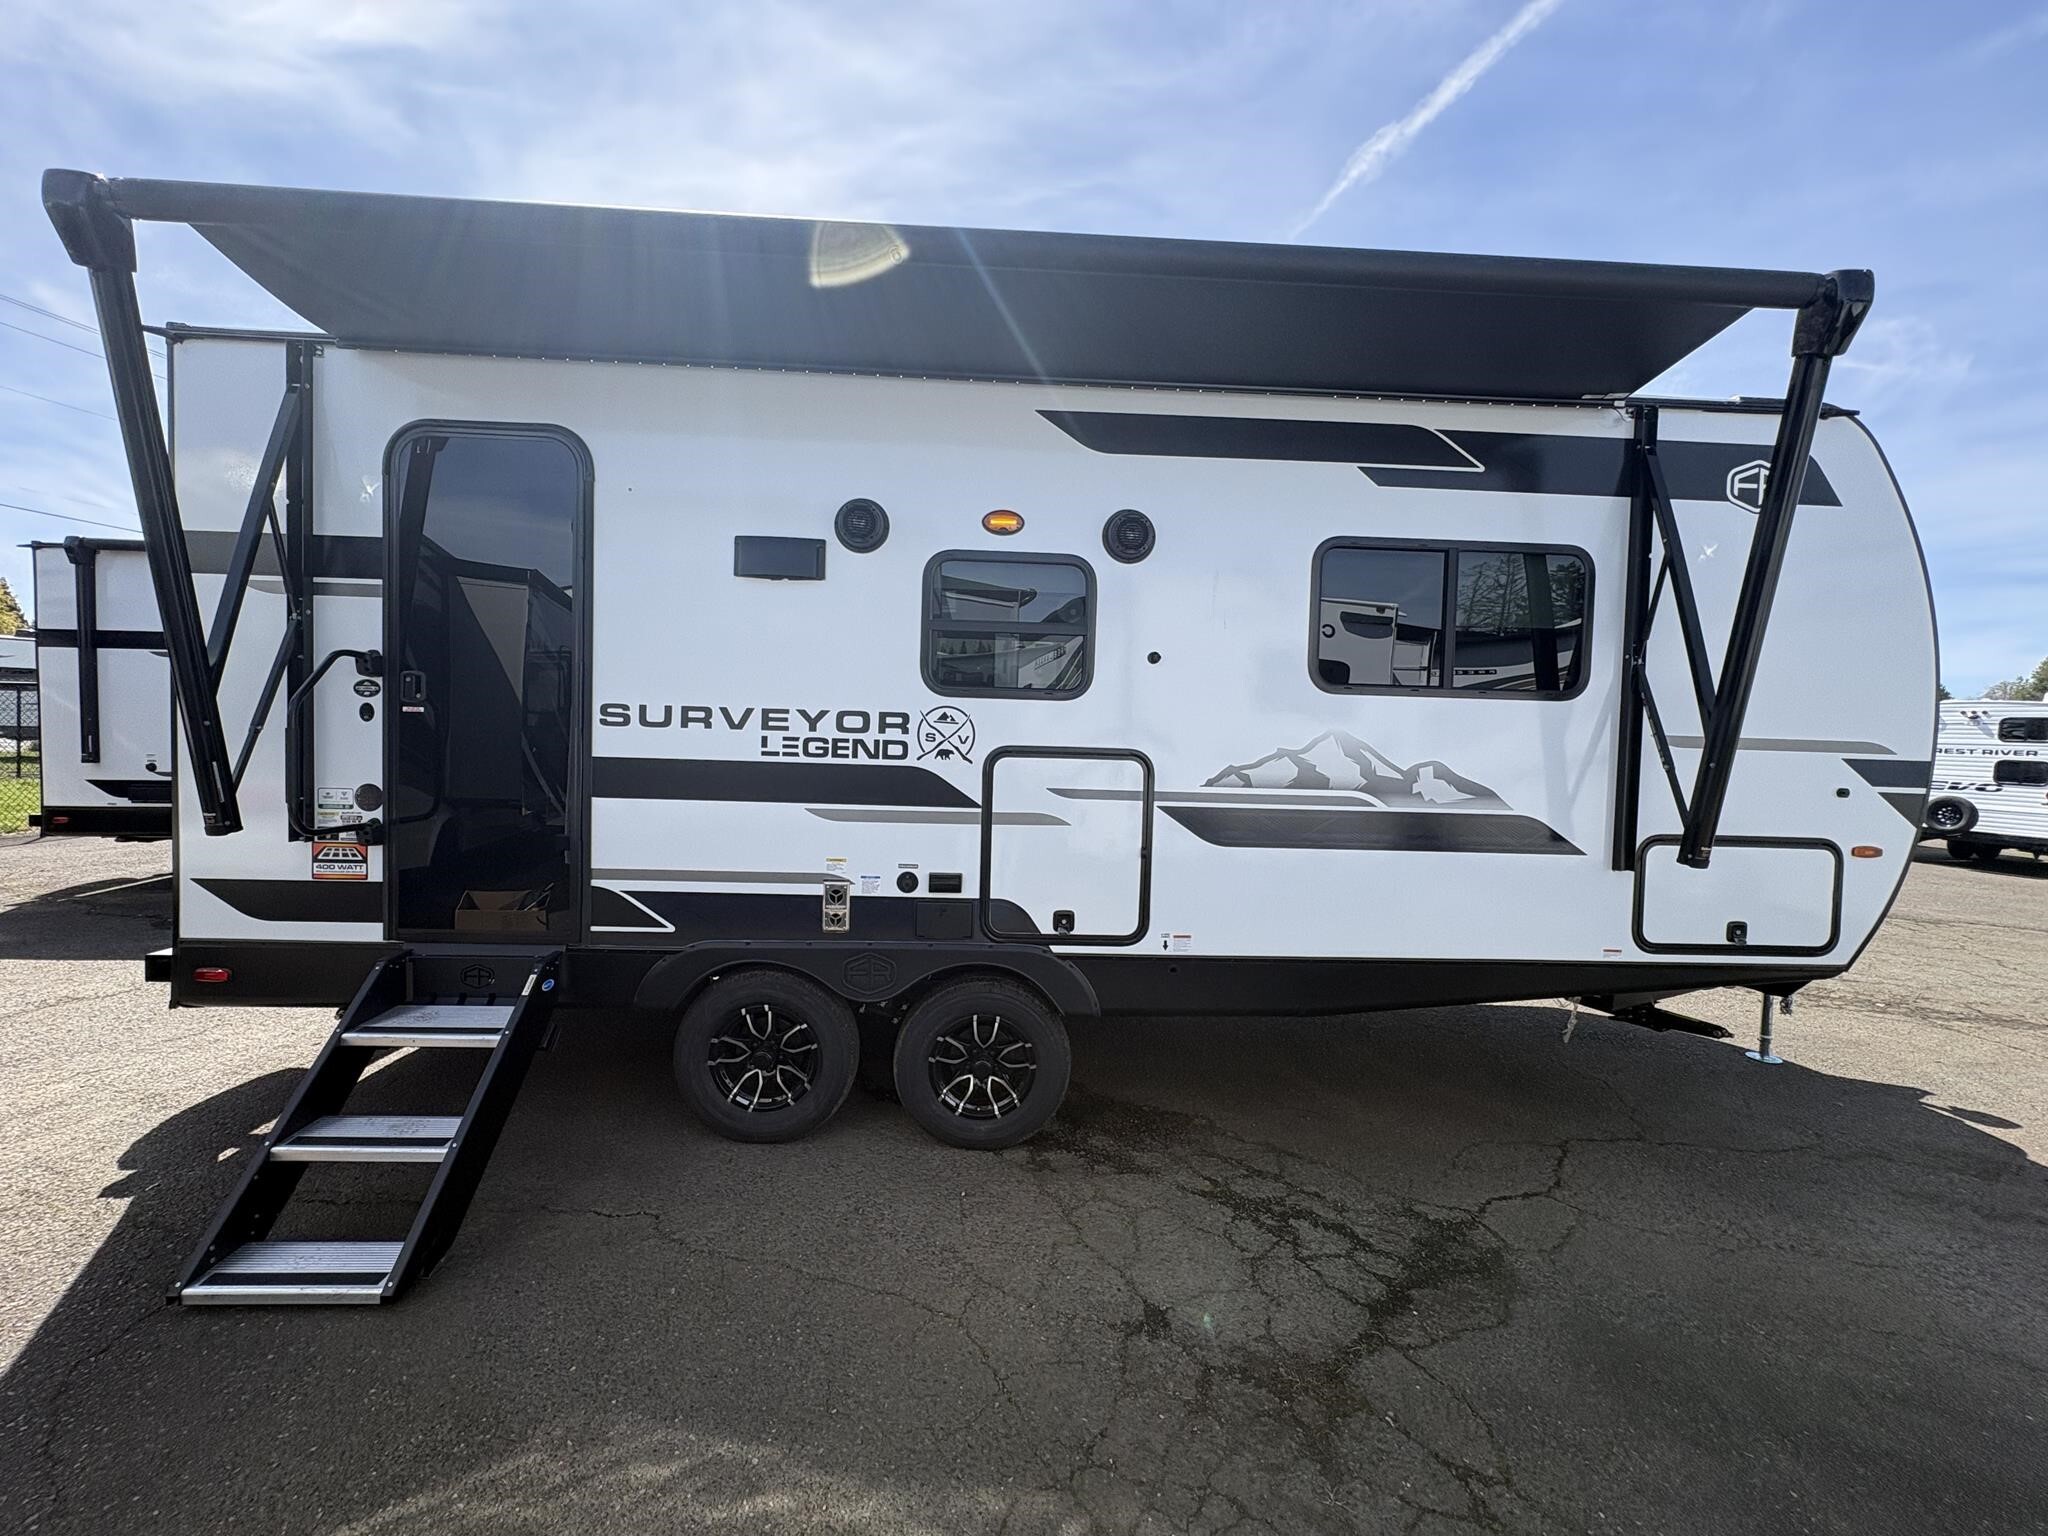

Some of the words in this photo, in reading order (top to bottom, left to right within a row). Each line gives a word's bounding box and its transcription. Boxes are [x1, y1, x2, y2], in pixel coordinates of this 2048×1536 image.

[599, 703, 910, 735] SURVEYOR
[761, 735, 909, 760] LEGEND
[925, 732, 937, 743] S
[957, 735, 970, 745] V
